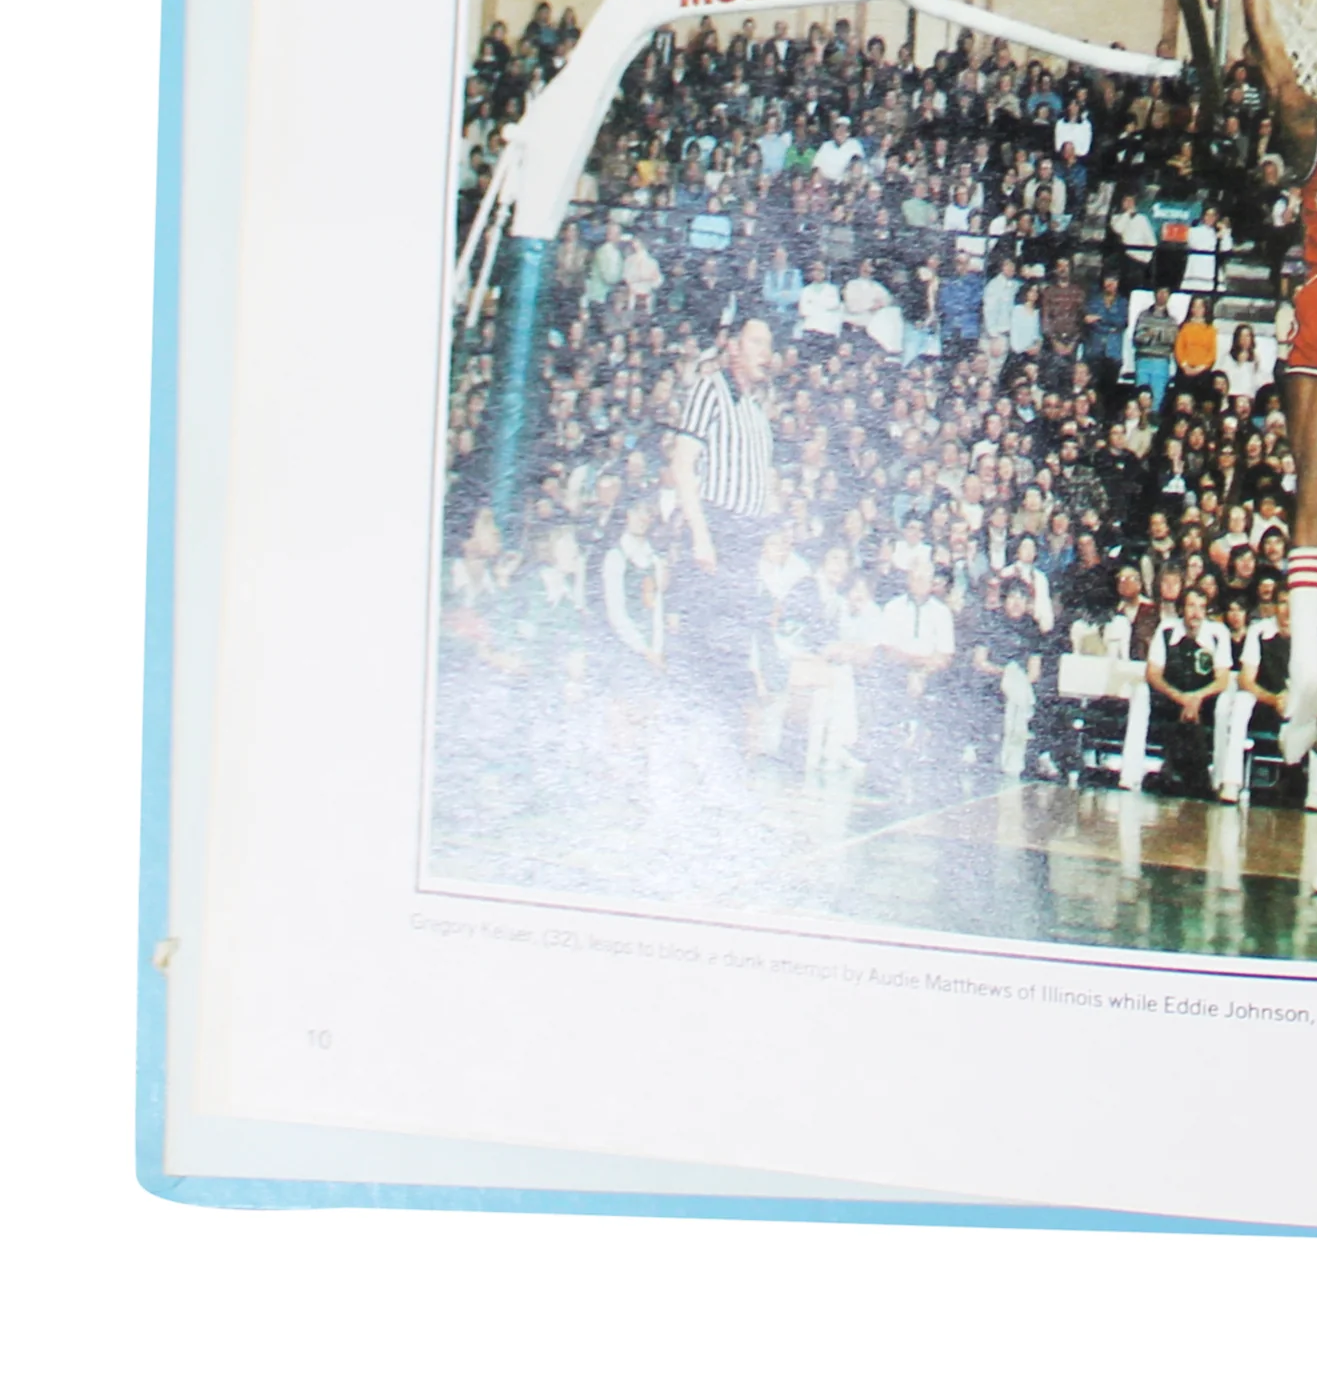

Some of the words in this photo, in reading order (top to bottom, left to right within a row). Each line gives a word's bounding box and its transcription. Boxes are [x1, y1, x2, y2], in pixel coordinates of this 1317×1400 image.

[842, 963, 864, 987] by
[867, 966, 921, 990] Audie
[924, 973, 1013, 999] Matthews
[1016, 984, 1037, 1002] of
[1041, 985, 1104, 1009] Illinois
[1107, 992, 1159, 1013] while
[1163, 995, 1220, 1018] Eddie
[1223, 1001, 1316, 1025] Johnson,
